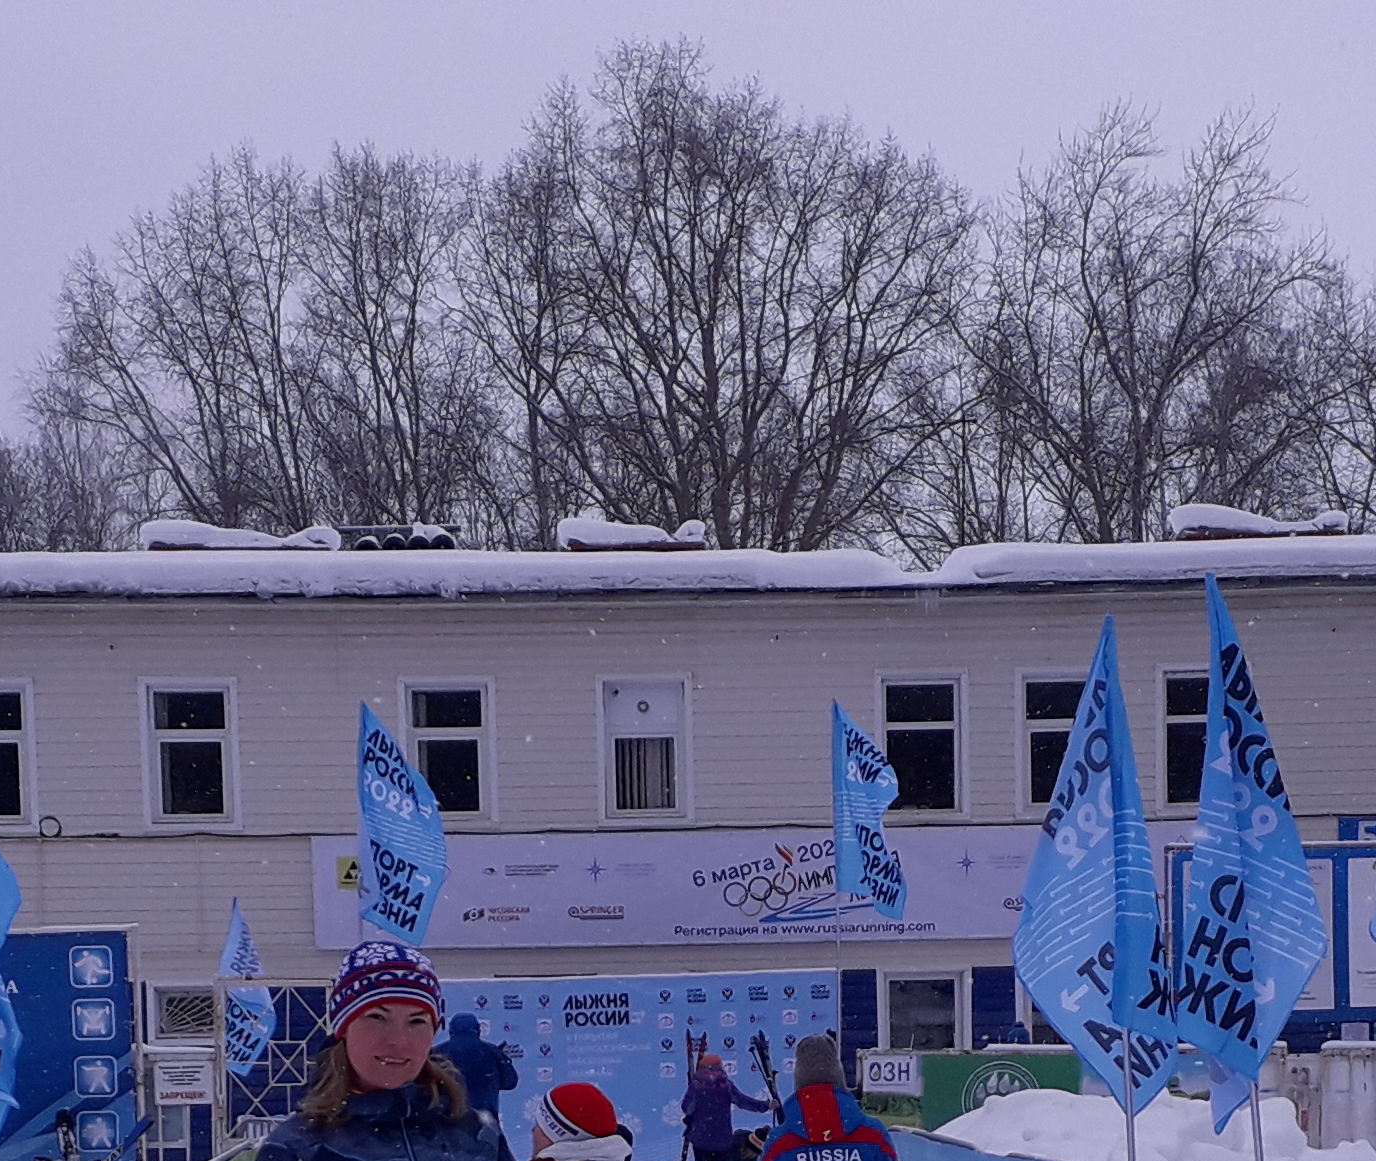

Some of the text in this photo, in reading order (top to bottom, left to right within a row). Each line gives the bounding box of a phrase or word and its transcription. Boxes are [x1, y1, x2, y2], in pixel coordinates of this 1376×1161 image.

[692, 869, 706, 887] 6
[711, 857, 776, 884] марта
[375, 866, 425, 912] РМА
[373, 892, 419, 933] ЗНИ
[674, 925, 759, 938] Регистрация
[762, 925, 778, 935] на
[562, 992, 630, 1012] ЛЫЖНЯ
[564, 1010, 630, 1028] РОССИИ
